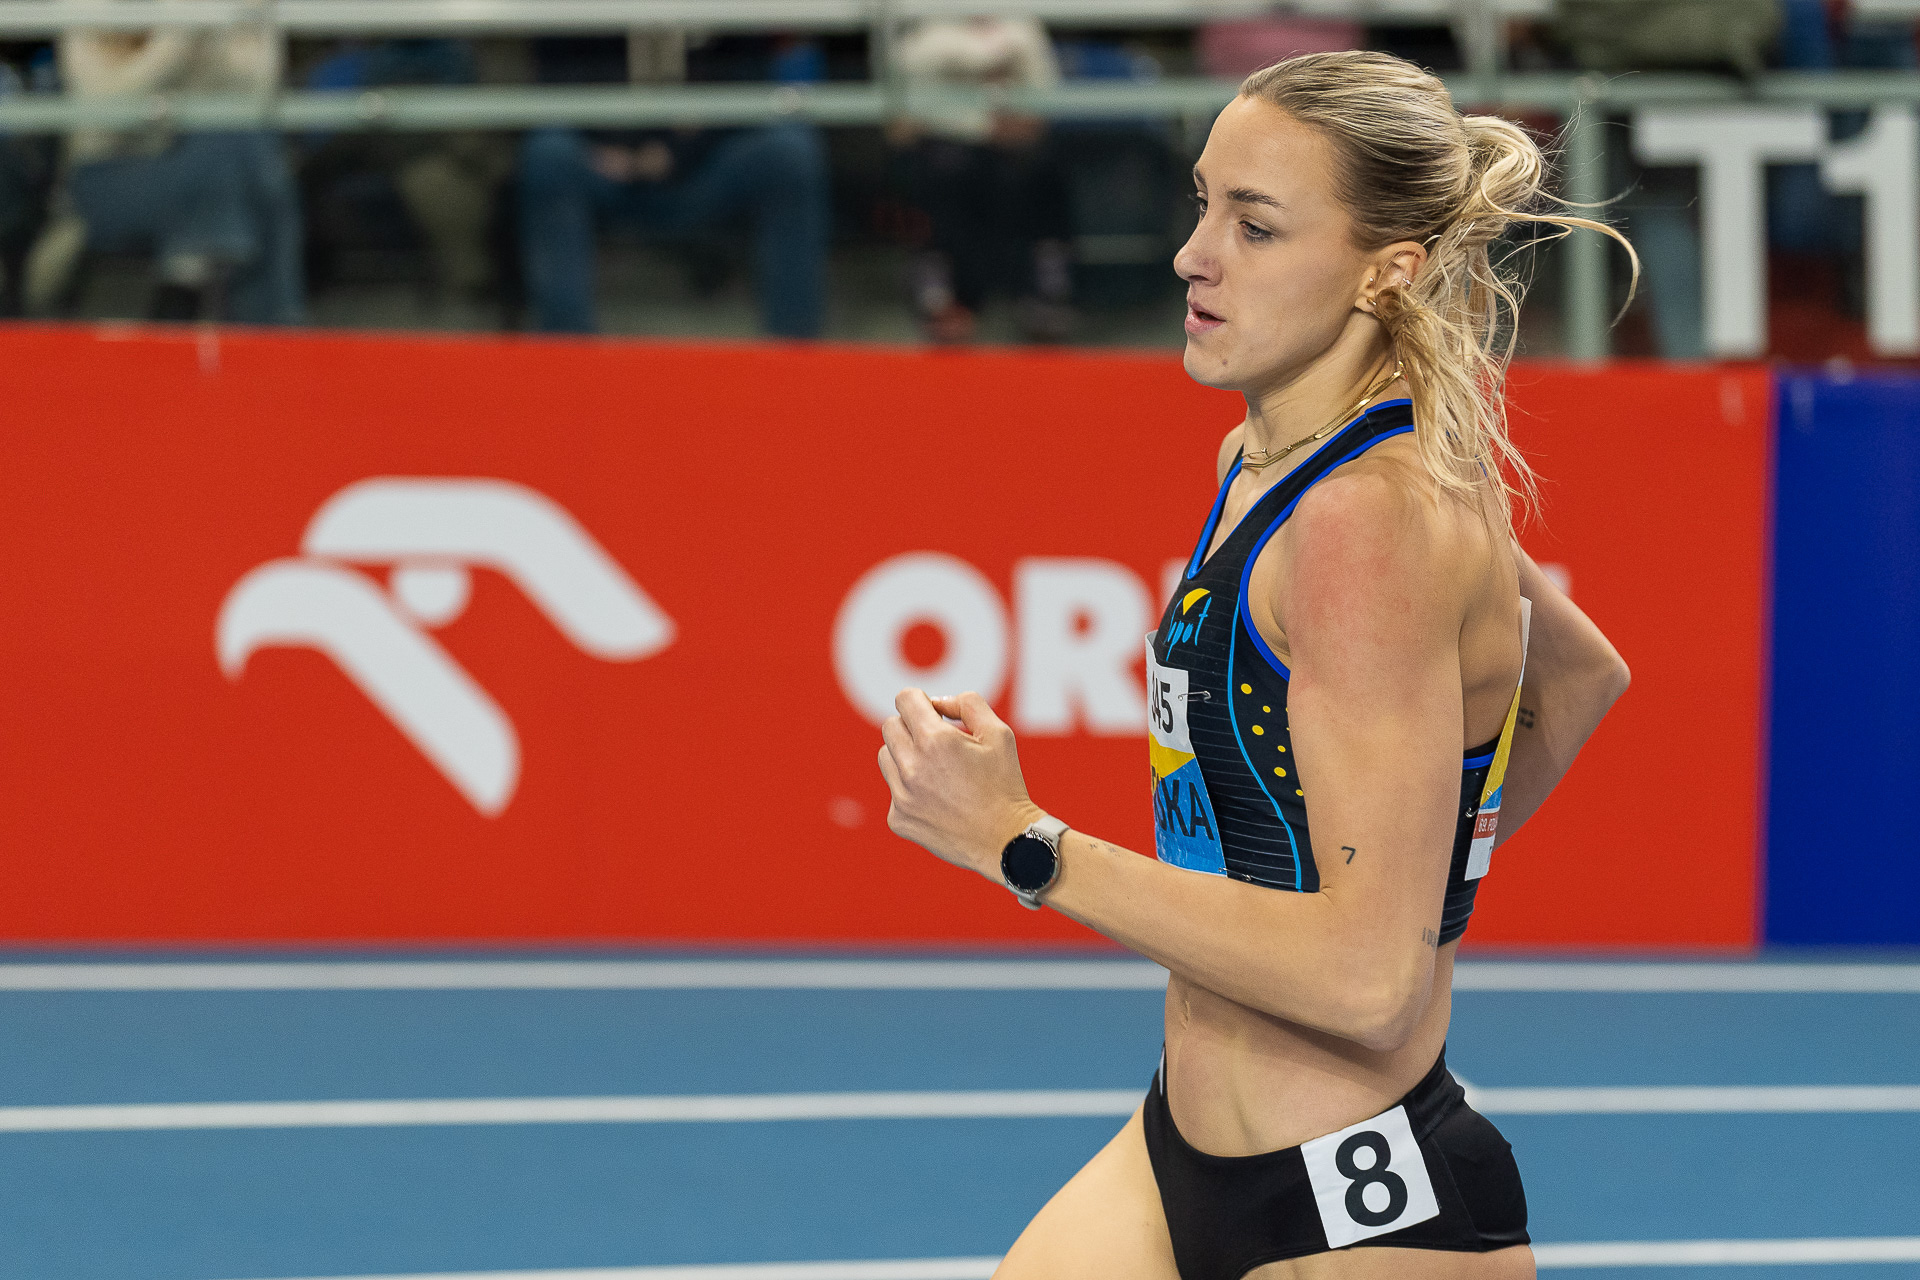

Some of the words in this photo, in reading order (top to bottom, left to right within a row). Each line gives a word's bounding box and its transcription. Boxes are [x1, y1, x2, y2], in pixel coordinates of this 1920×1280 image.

[1151, 670, 1174, 734] 45
[1151, 765, 1215, 841] SKA
[1341, 846, 1356, 865] 7
[1335, 1130, 1408, 1227] 8
